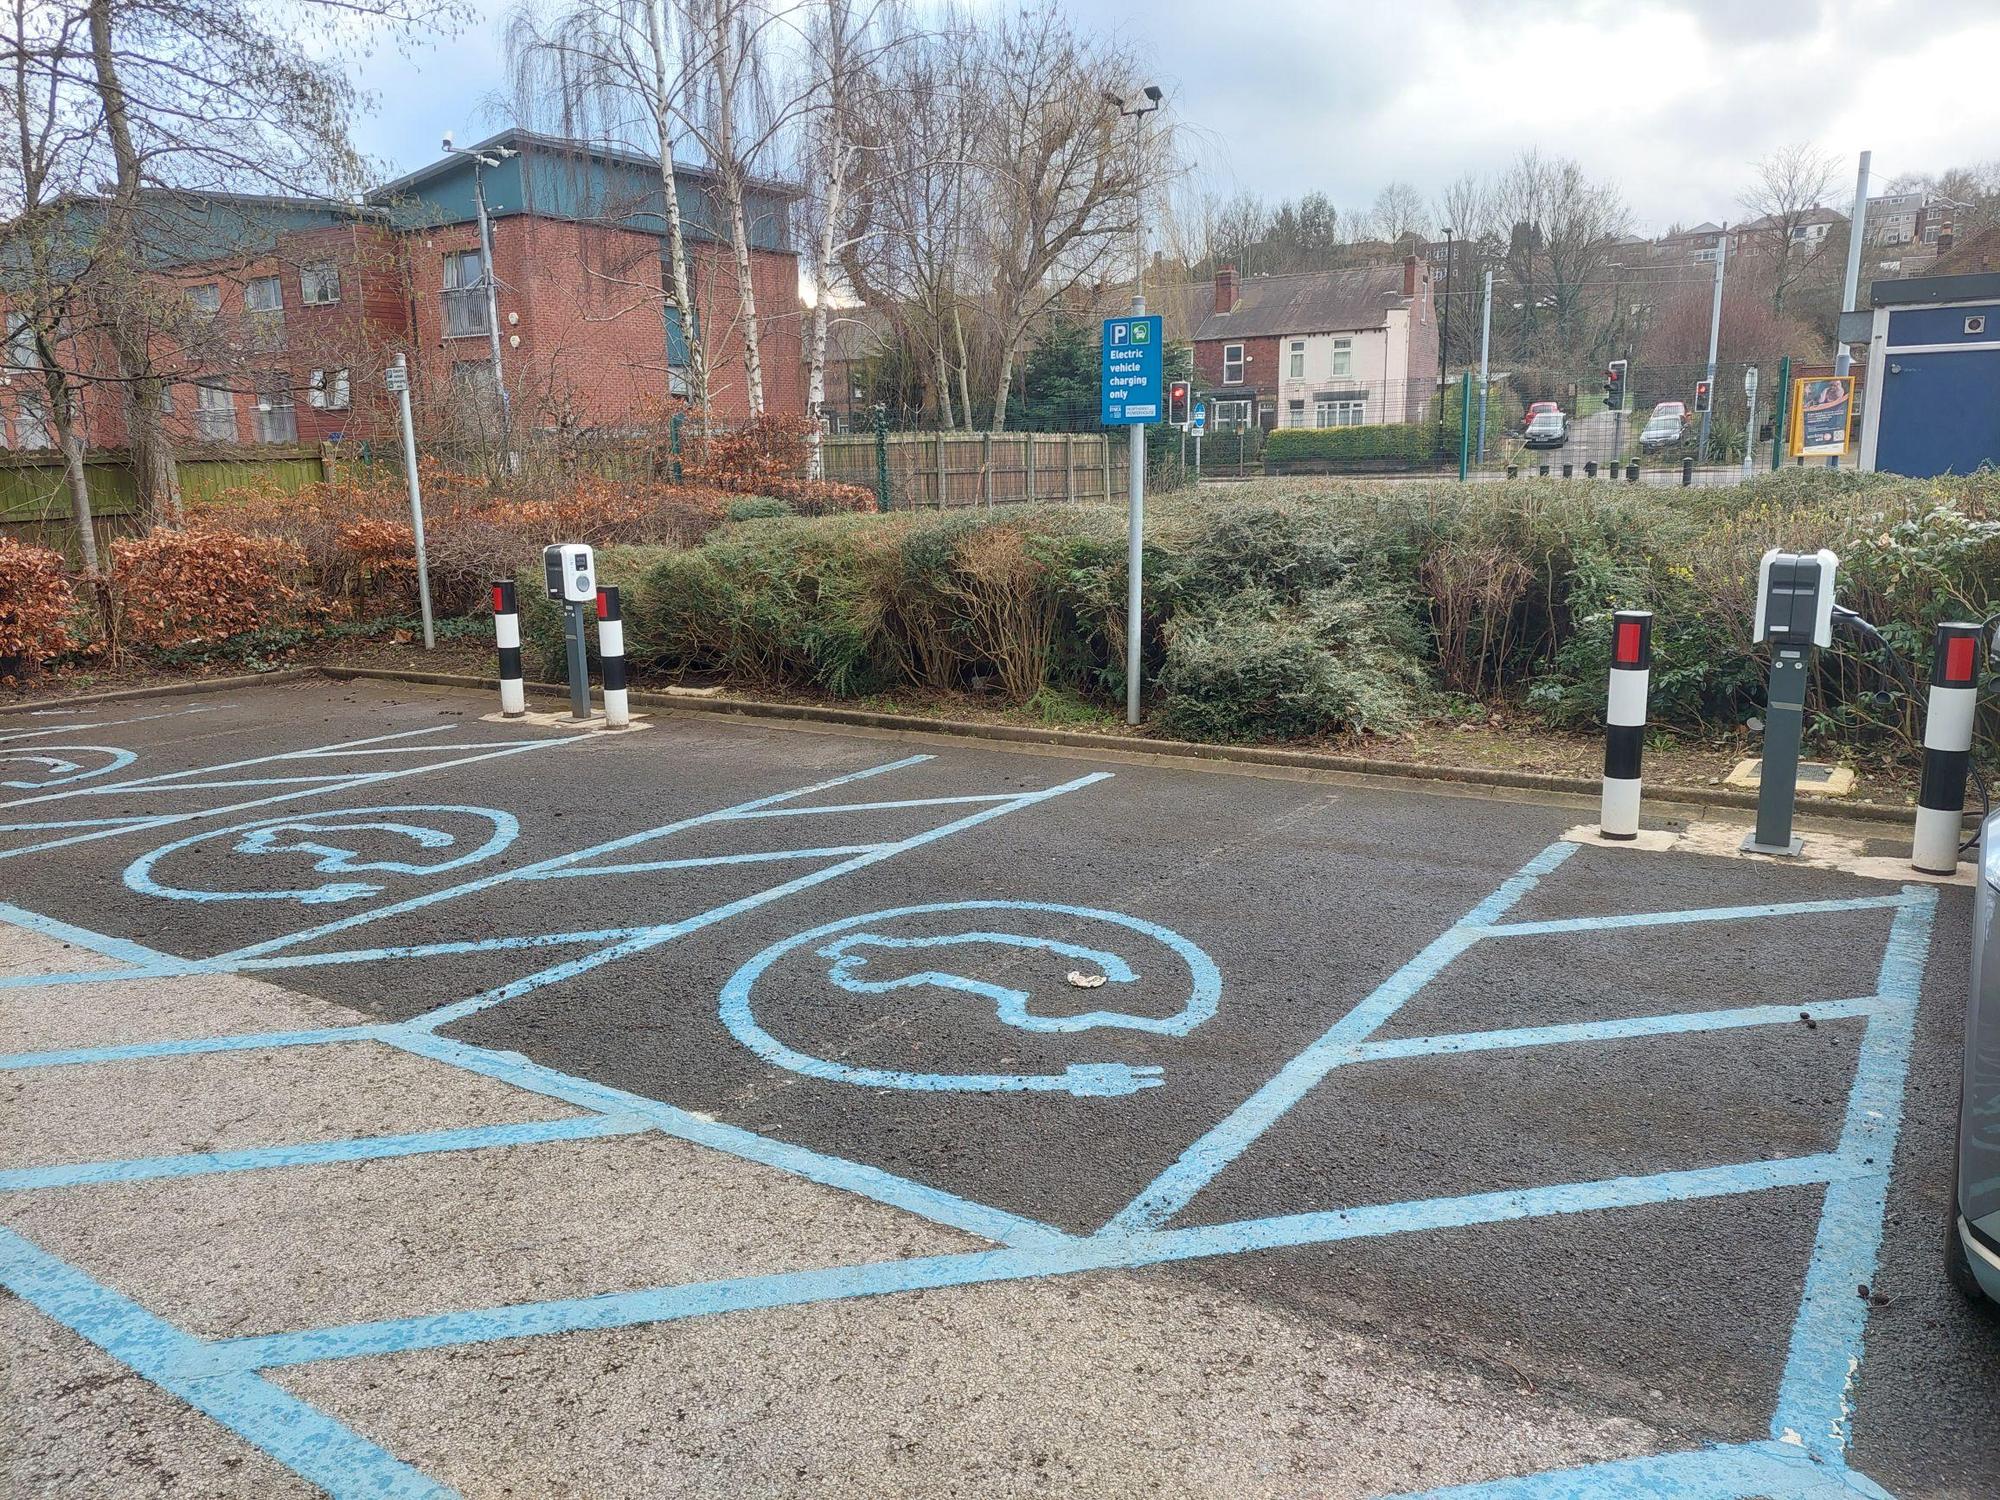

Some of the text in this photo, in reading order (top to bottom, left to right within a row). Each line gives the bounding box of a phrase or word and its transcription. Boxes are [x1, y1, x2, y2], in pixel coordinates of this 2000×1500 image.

[1114, 325, 1126, 344] P
[1110, 349, 1143, 359] Electric
[1110, 362, 1141, 372] vehicle
[1110, 375, 1147, 387] charging
[1110, 389, 1128, 400] only
